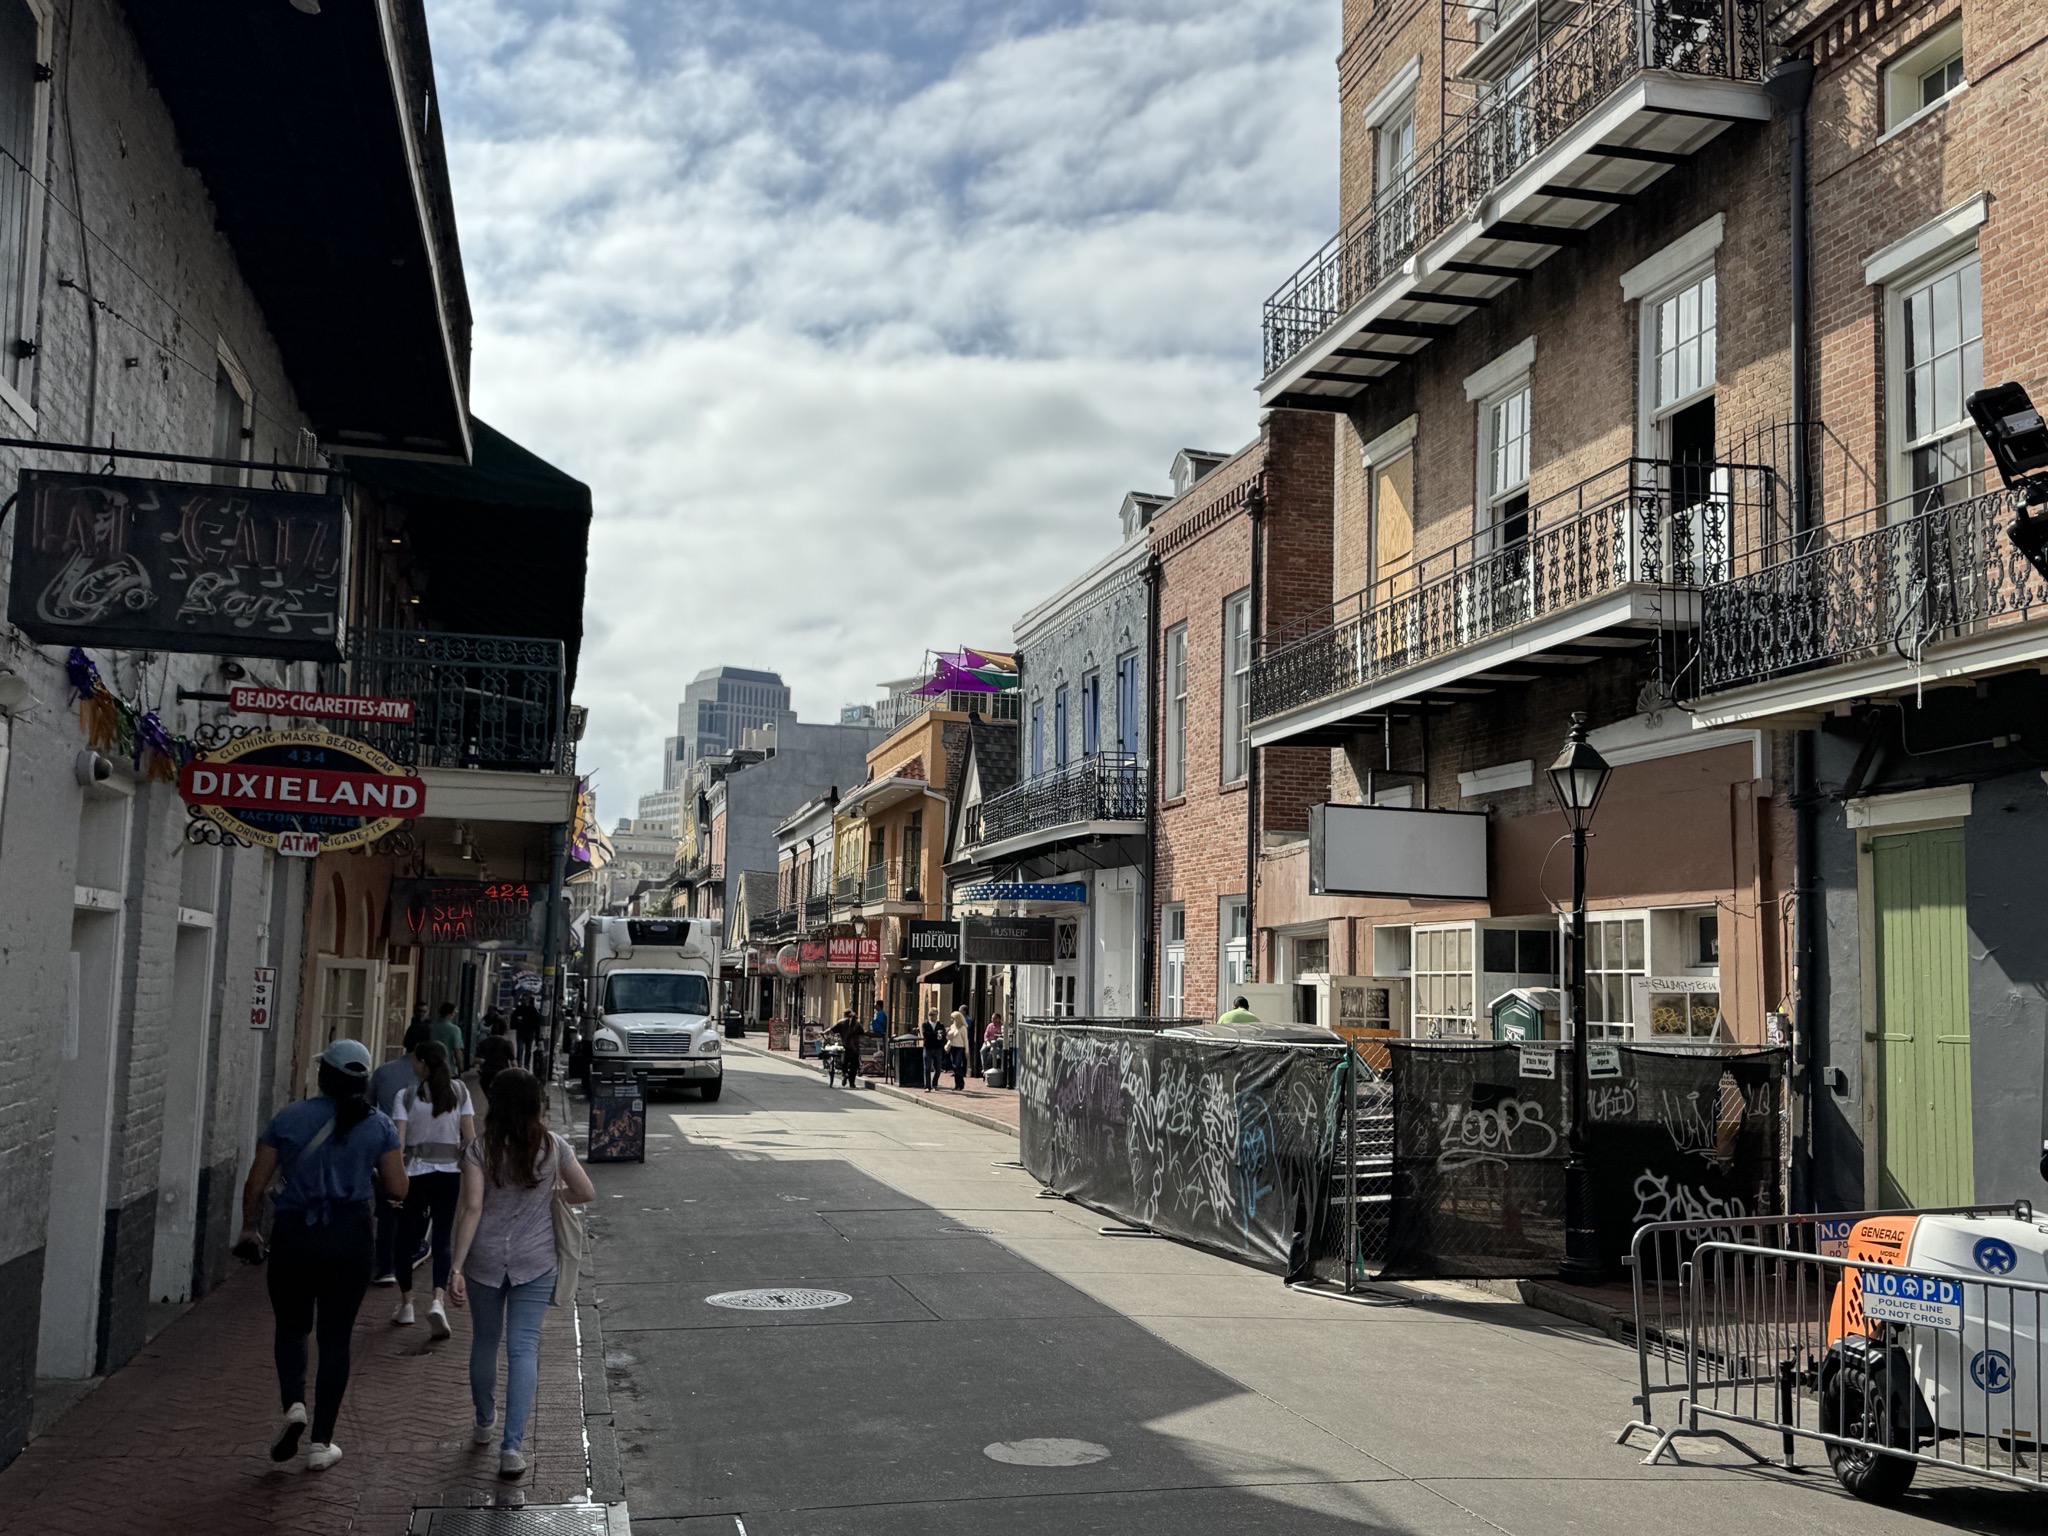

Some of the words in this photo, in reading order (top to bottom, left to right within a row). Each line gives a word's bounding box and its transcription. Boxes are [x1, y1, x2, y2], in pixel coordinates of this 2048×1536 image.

[236, 690, 286, 710] BEADS
[289, 694, 375, 716] CIGARETTES
[377, 703, 410, 719] ATM
[219, 733, 276, 760] CLOTHING
[280, 733, 321, 743] MASKS
[325, 734, 364, 754] BEADS
[365, 750, 395, 773] CIGAR
[287, 751, 326, 764] 434
[191, 770, 418, 809] DIXIELAND
[209, 806, 234, 830] SOFT
[235, 823, 274, 845] DRINKS
[280, 834, 319, 852] ATM
[484, 883, 529, 898] 424
[433, 897, 530, 920] SEAFOOD
[432, 918, 529, 942] MARKET
[911, 932, 959, 949] HIDEOUT
[1537, 1058, 1548, 1067] Way
[1597, 1058, 1609, 1066] Open
[1860, 1226, 1905, 1242] GENERAC
[1879, 1249, 1900, 1259] MOBILE
[1866, 1272, 1900, 1296] N.O.
[1922, 1285, 1958, 1304] P.D.
[1878, 1297, 1917, 1312] POLICE
[1919, 1303, 1944, 1315] LINE
[1871, 1307, 1886, 1316] DO
[1888, 1308, 1911, 1320] NOT
[1913, 1313, 1952, 1326] CROSS
